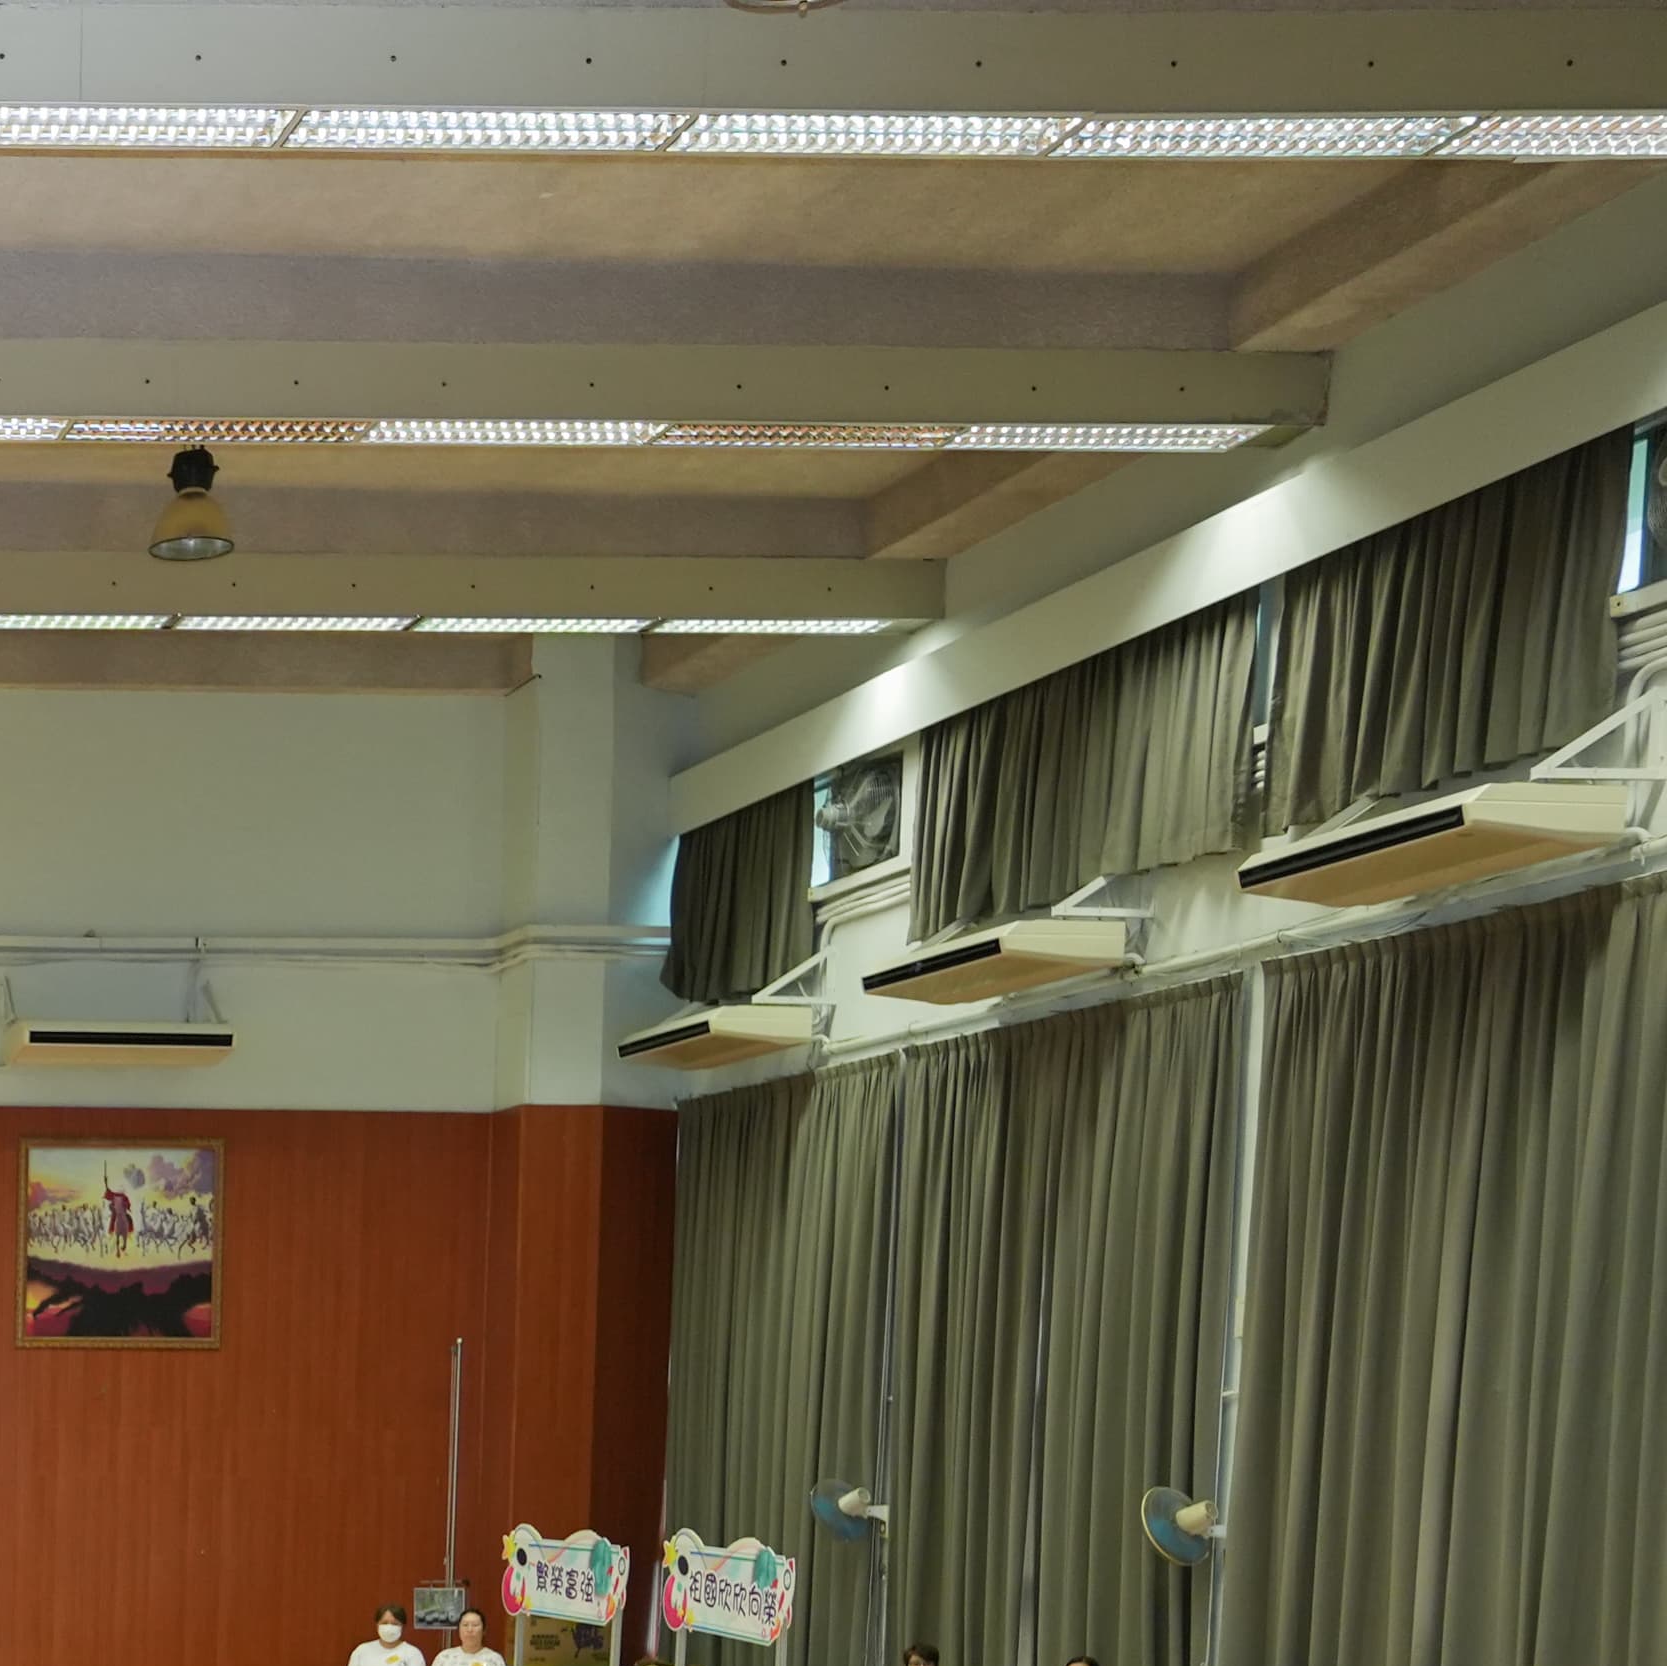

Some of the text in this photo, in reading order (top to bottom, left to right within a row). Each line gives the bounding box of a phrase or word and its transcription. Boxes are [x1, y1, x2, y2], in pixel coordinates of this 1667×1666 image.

[689, 1569, 778, 1627] 祖國欣欣向榮
